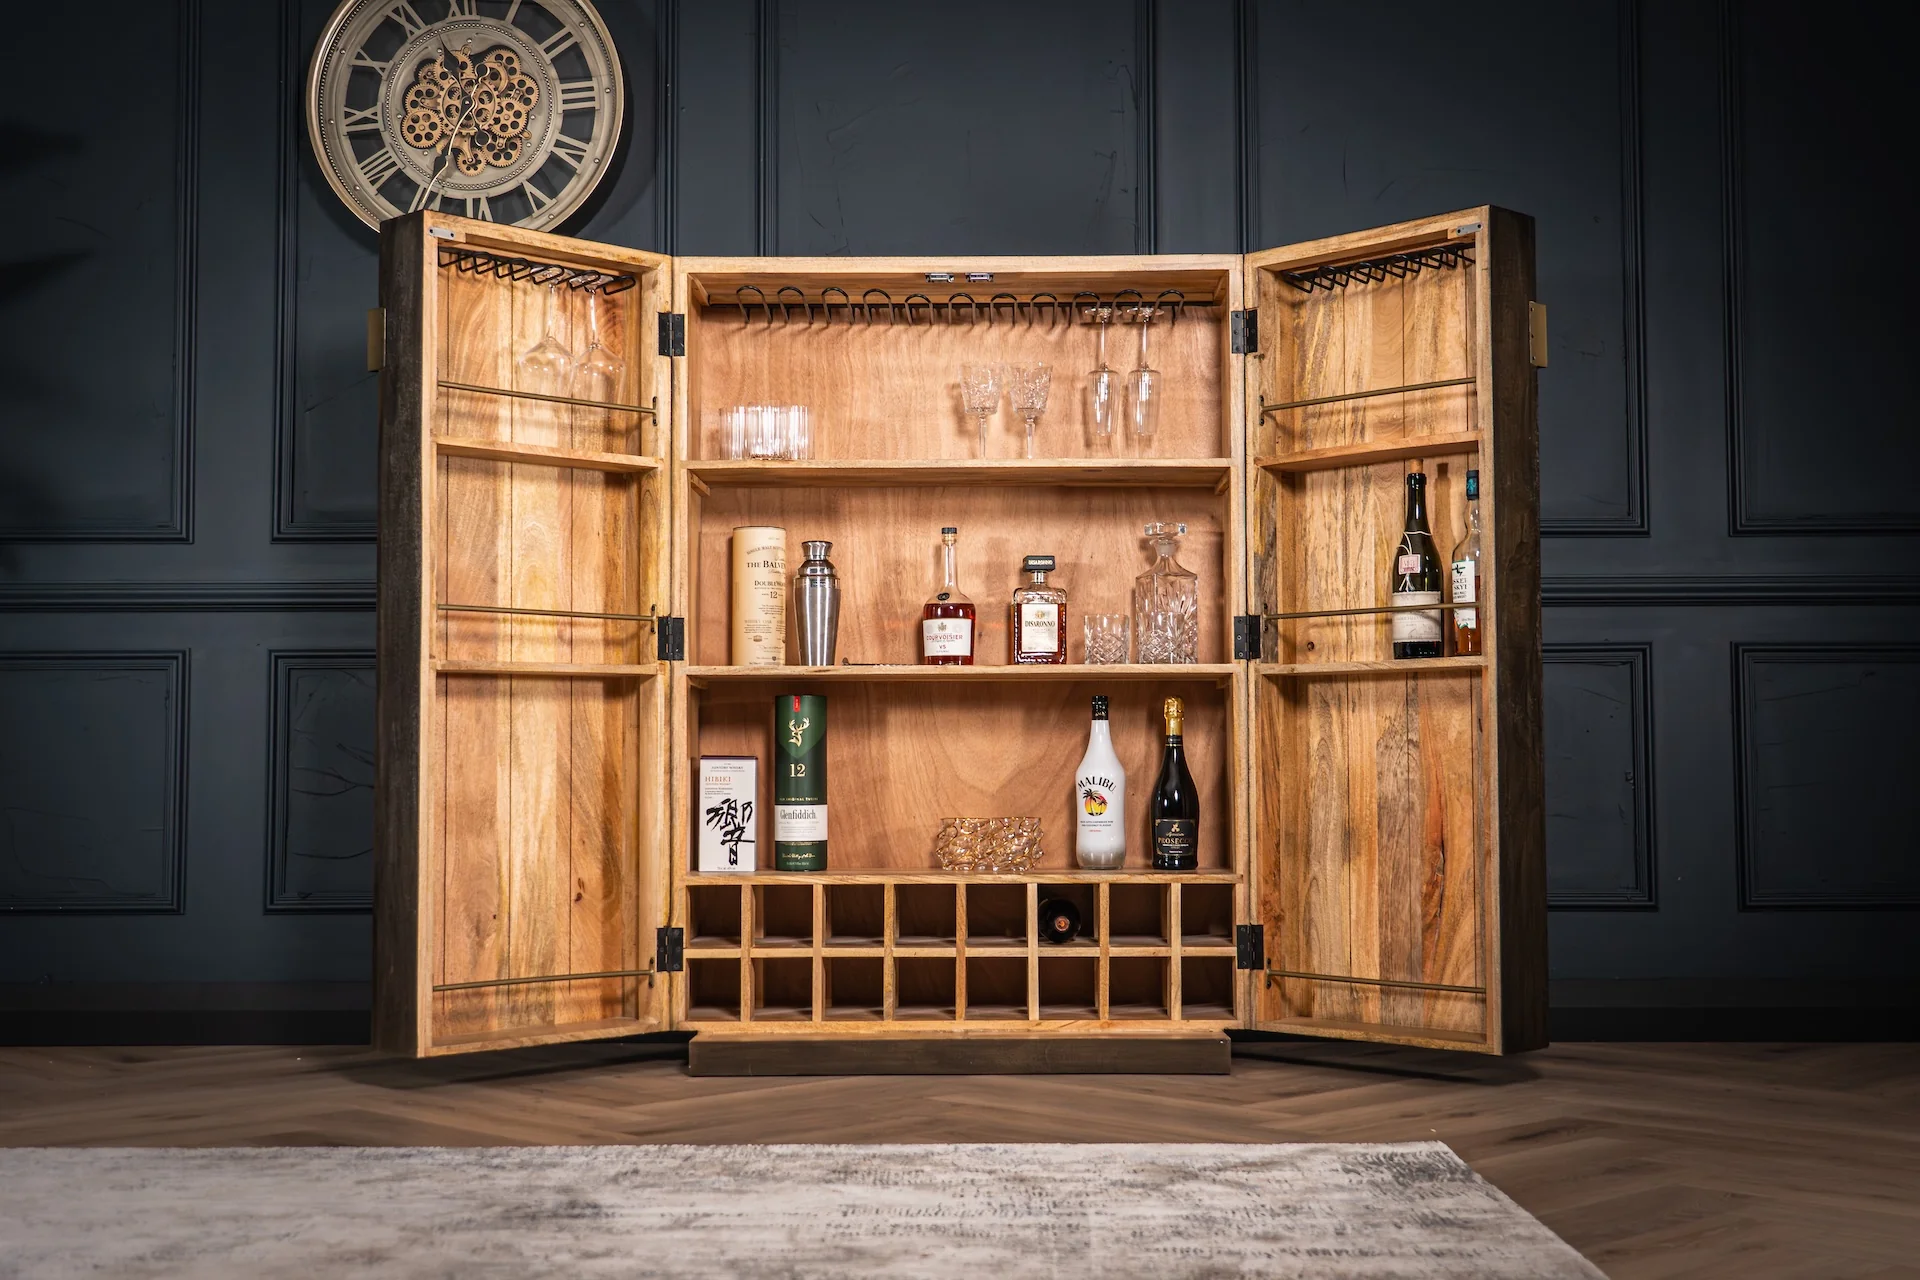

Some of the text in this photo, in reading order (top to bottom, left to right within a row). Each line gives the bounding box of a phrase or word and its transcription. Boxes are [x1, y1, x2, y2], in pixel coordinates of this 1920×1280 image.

[770, 591, 778, 599] 12
[1025, 620, 1055, 628] DISARONNO
[789, 763, 806, 777] 12
[1078, 776, 1116, 793] MALIBU
[780, 809, 817, 820] Glenfiddich
